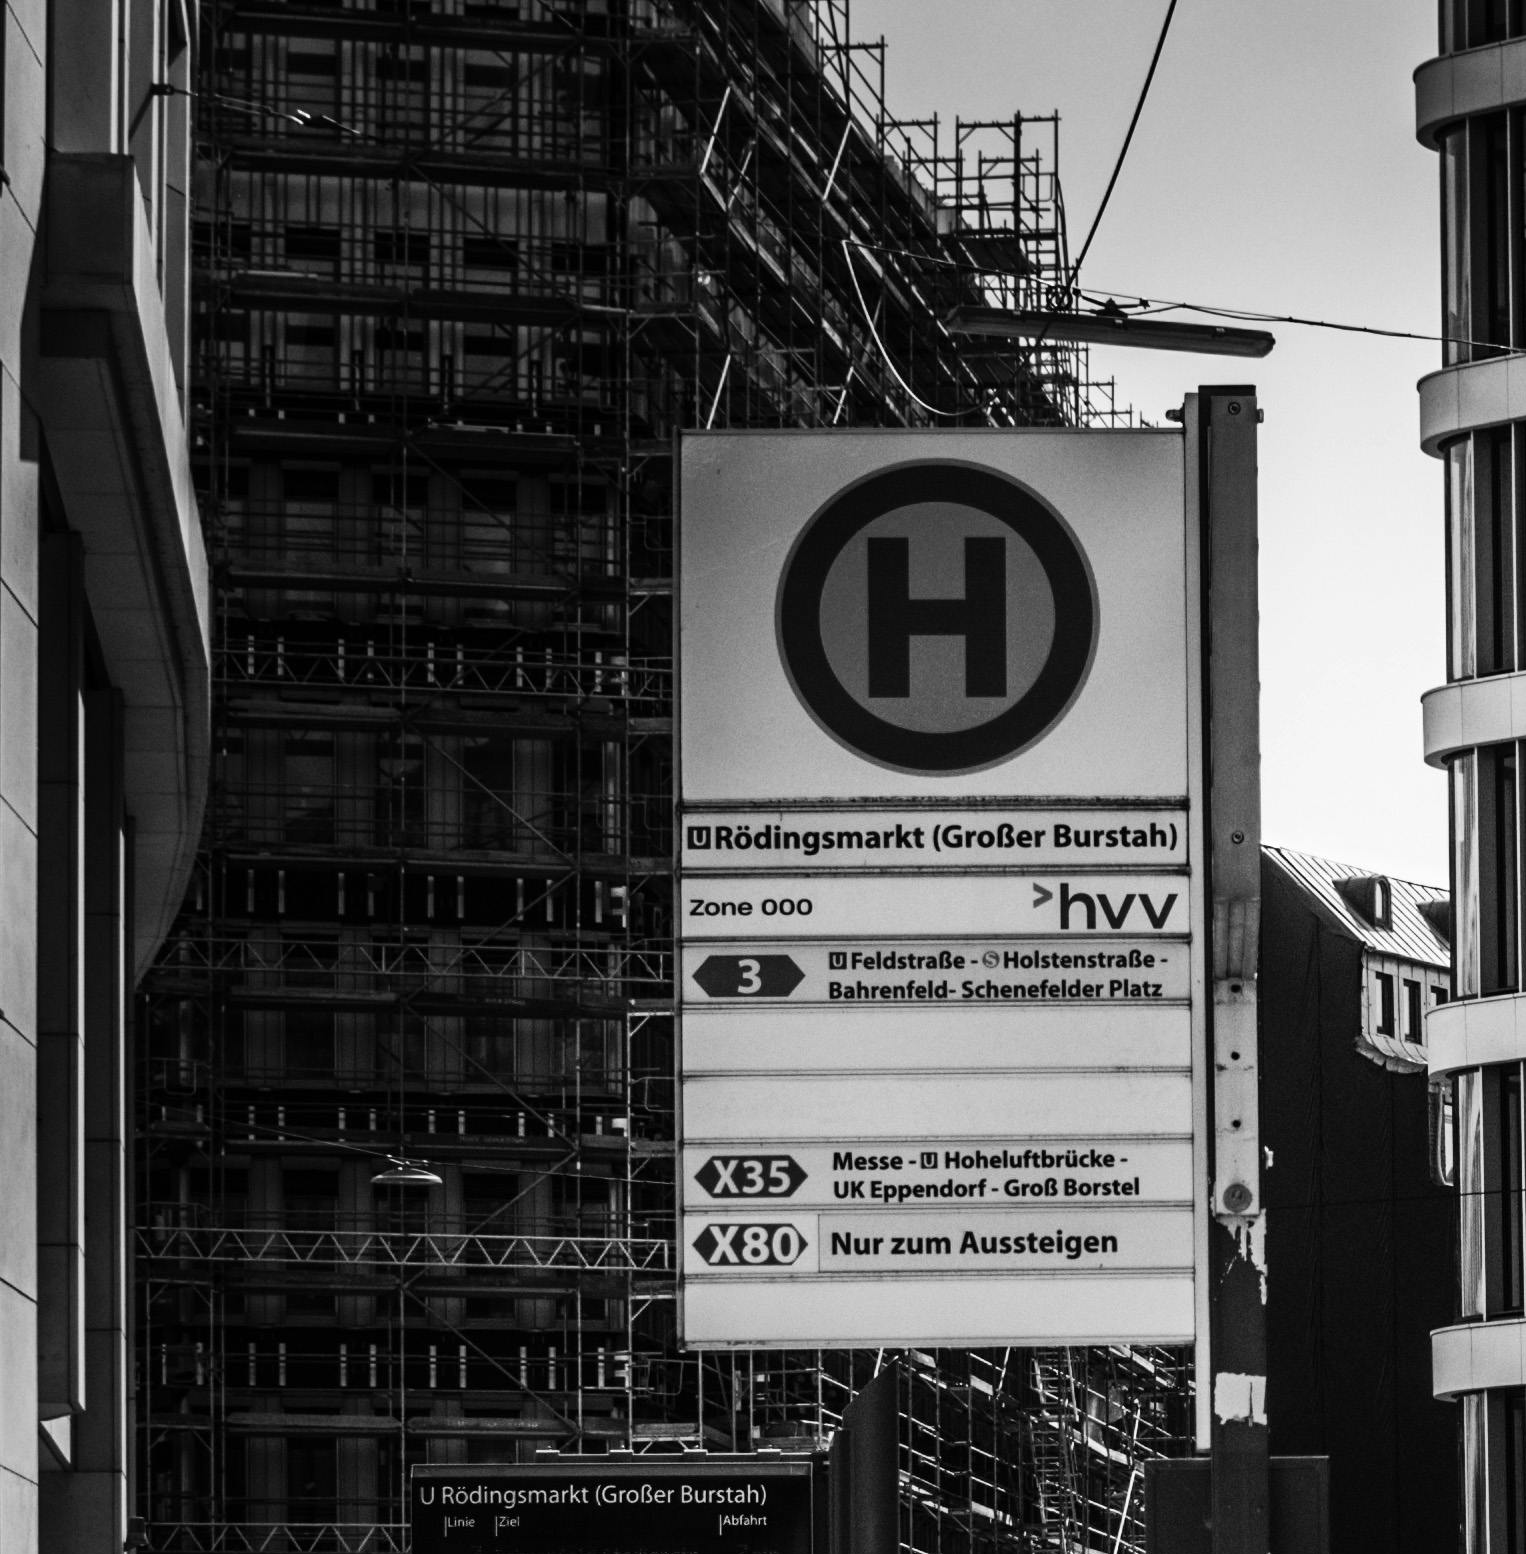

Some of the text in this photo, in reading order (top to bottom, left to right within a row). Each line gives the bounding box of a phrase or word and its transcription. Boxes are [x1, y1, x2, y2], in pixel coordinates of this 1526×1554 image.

[867, 537, 1007, 698] H
[715, 826, 924, 856] Rödingsmarkt
[933, 824, 1045, 853] (Großer
[1054, 823, 1178, 850] Burstah)
[690, 898, 813, 917] Zone 000
[851, 952, 965, 971] Feldstraße
[1004, 950, 1155, 970] Holstenstraße
[737, 959, 761, 995] 3
[962, 980, 1105, 999] Schenefelder
[1109, 980, 1163, 999] Platz
[833, 1151, 903, 1171] Messe
[945, 1149, 1115, 1169] Hoheluftbrücke
[712, 1160, 791, 1194] X35
[833, 1180, 865, 1199] UK
[871, 1179, 987, 1202] Eppendorf
[1004, 1179, 1058, 1197] Groß
[1063, 1178, 1140, 1196] Borstel
[709, 1225, 799, 1264] X80
[832, 1231, 1118, 1260] Nur zum Aussteigen
[420, 1484, 768, 1508] U Rödingsmarkt (Großer Burstah)
[447, 1515, 475, 1528] Linie
[499, 1515, 520, 1527] Ziel
[723, 1514, 767, 1526] Abfahrt
